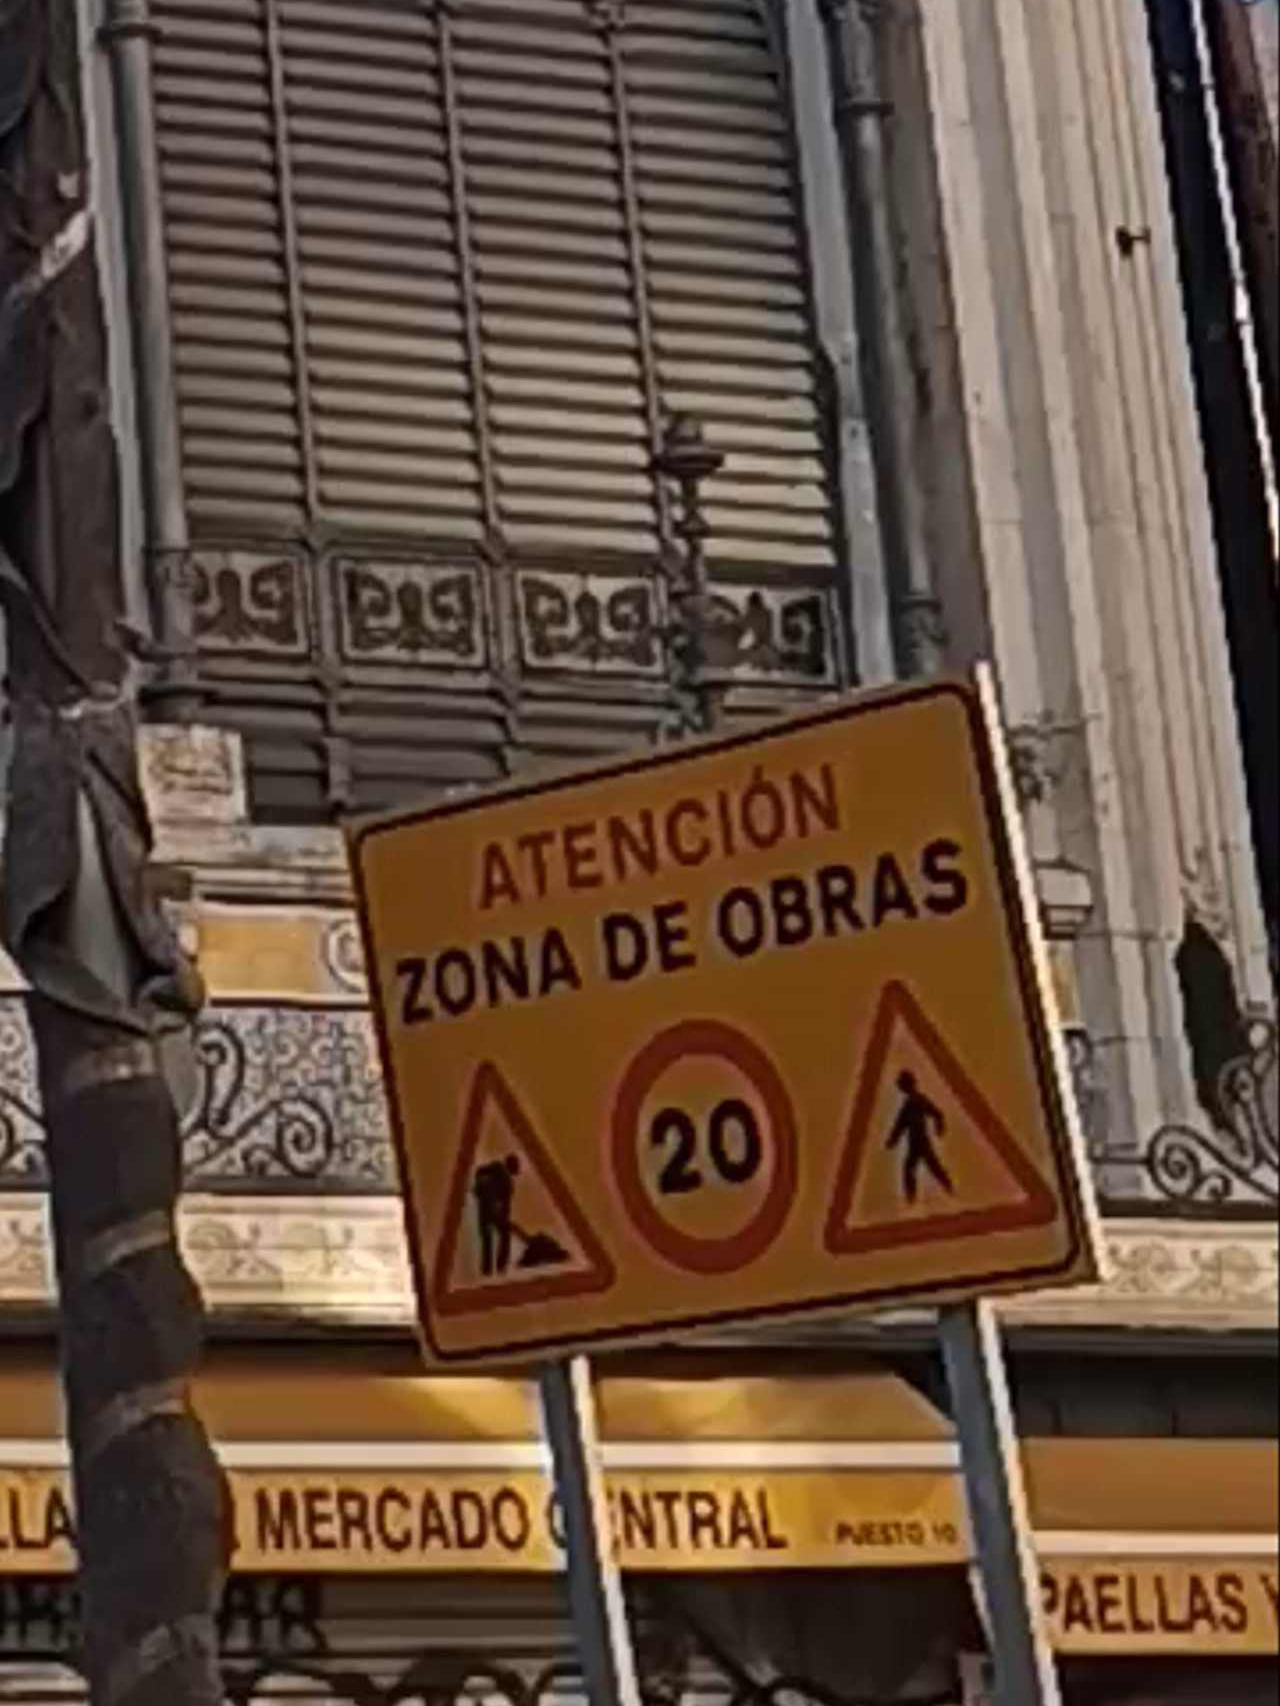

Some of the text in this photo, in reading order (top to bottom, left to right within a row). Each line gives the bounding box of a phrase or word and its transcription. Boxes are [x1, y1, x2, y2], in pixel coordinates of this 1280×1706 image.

[479, 764, 842, 910] ATENCIÓN
[395, 837, 970, 1025] ZONA DE OBRAS
[650, 1097, 763, 1196] 20
[254, 1485, 531, 1553] MERCADO
[835, 1521, 925, 1547] PUESTO
